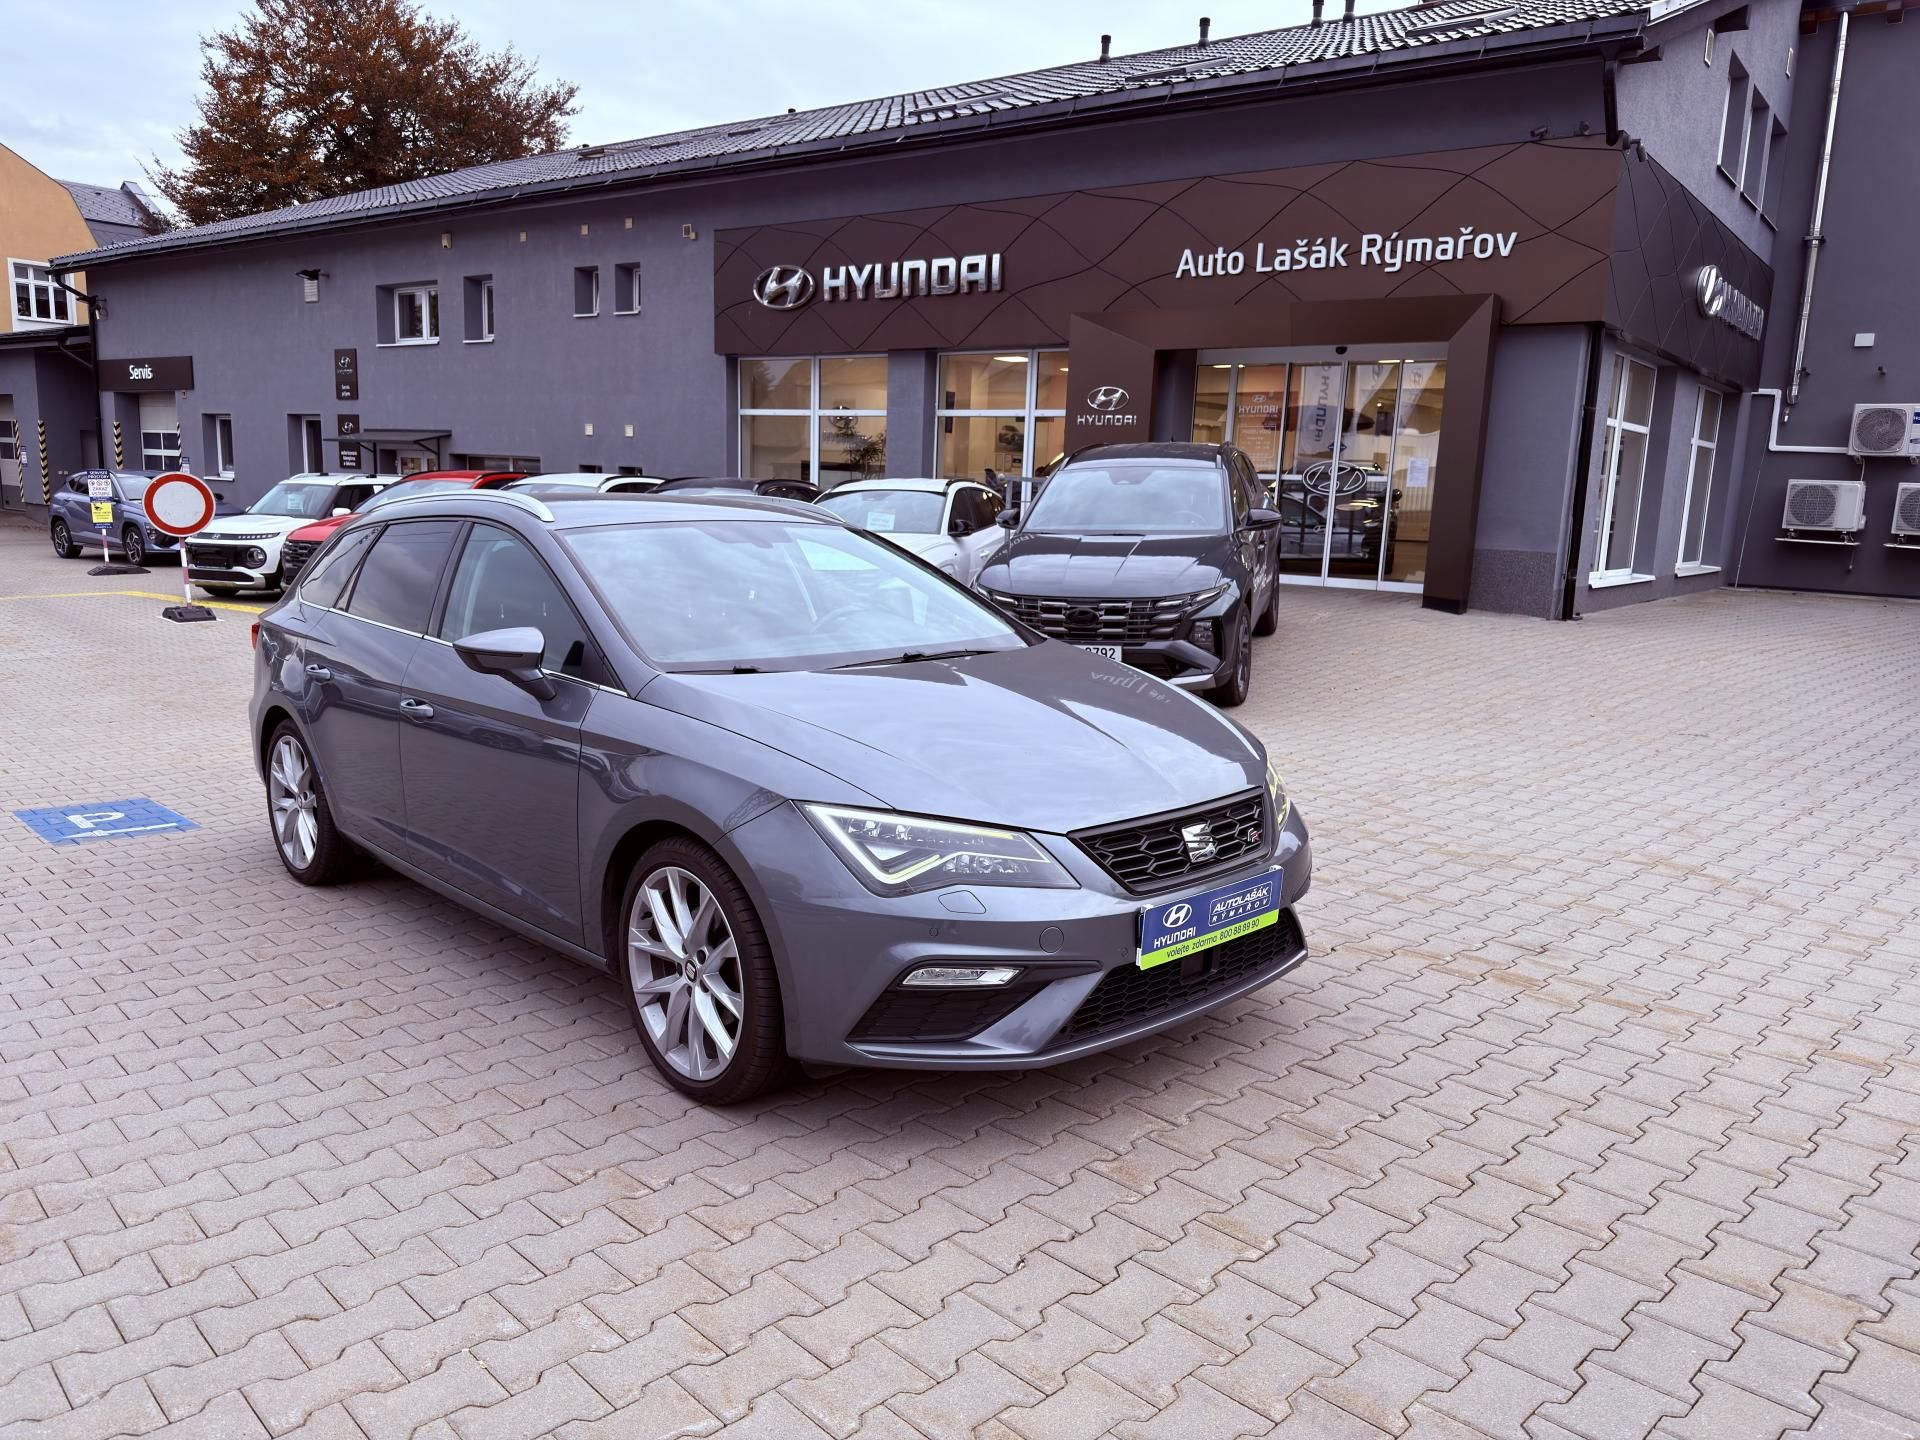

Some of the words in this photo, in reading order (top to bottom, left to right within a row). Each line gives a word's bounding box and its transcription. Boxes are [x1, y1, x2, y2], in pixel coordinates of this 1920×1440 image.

[1175, 247, 1245, 279] Auto
[1255, 236, 1349, 273] Lašák
[1360, 226, 1518, 273] Rýmařov
[823, 253, 1001, 302] HYUNDAI
[128, 364, 153, 380] Servis
[1077, 414, 1137, 426] HYUNDAI
[1238, 405, 1279, 414] HYUNDAI
[1153, 927, 1196, 949] HYUNDAI
[1166, 944, 1190, 959] volejte
[1191, 934, 1218, 951] zdarma
[1219, 928, 1233, 941] 800
[1233, 924, 1242, 936] 88
[1242, 921, 1251, 932] 89
[1251, 918, 1260, 929] 90
